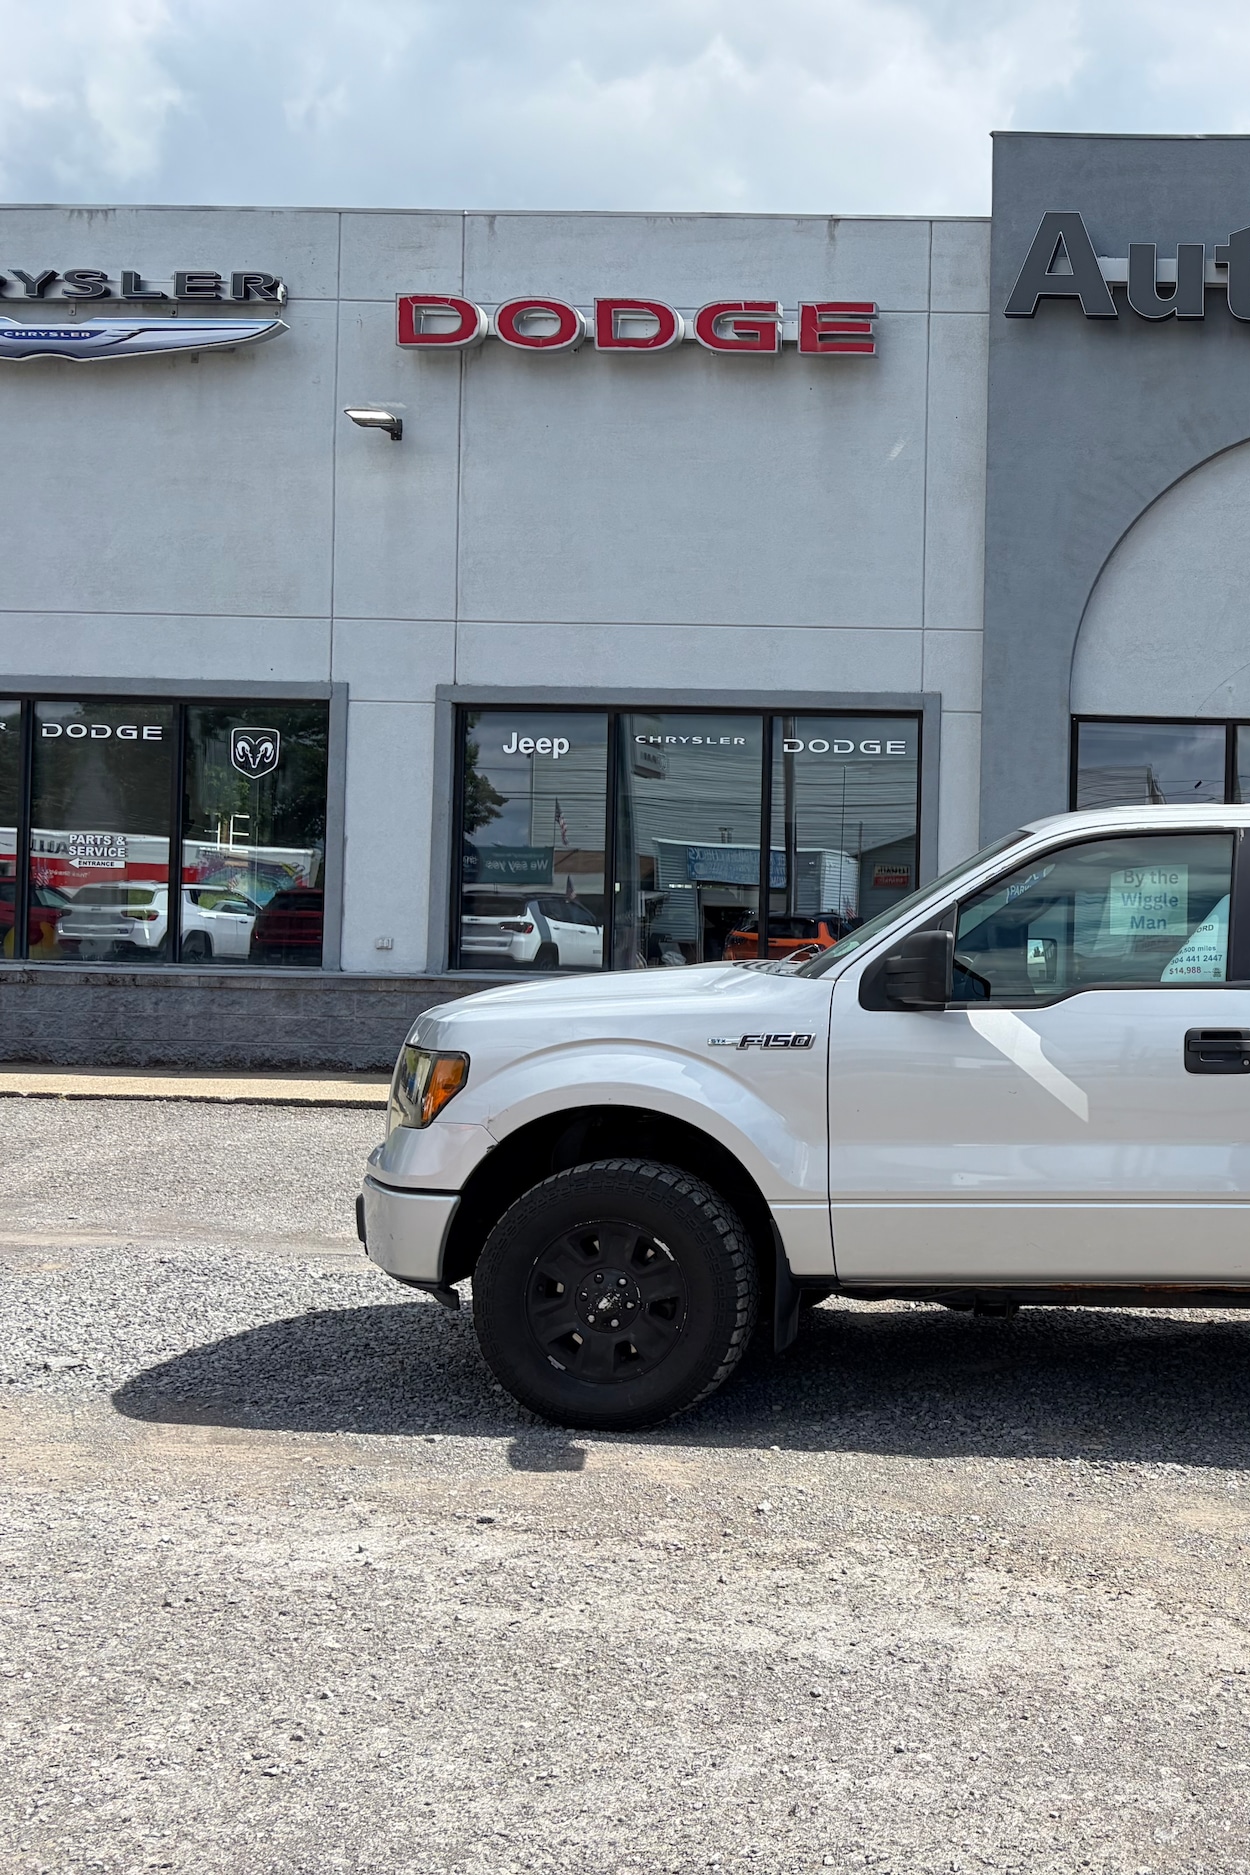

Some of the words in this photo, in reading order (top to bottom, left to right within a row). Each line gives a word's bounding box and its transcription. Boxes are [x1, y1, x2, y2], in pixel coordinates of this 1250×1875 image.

[0, 268, 280, 301] YSLER
[396, 292, 880, 358] DODGE
[3, 330, 91, 338] CHRYSLER
[41, 722, 163, 741] DODGE
[634, 735, 746, 745] CHRYSLER
[502, 731, 570, 758] Jeep
[783, 738, 907, 755] DODGE
[69, 834, 112, 846] PARTS
[116, 835, 126, 846] &
[68, 846, 126, 858] SERVICE
[1123, 870, 1145, 888] By
[1150, 869, 1179, 884] the
[1121, 892, 1179, 911] Wiggle
[1129, 915, 1167, 930] Man
[1186, 955, 1200, 963] 441
[1203, 954, 1223, 962] 2447
[1169, 966, 1202, 975] $14,988
[738, 1032, 815, 1050] F-150
